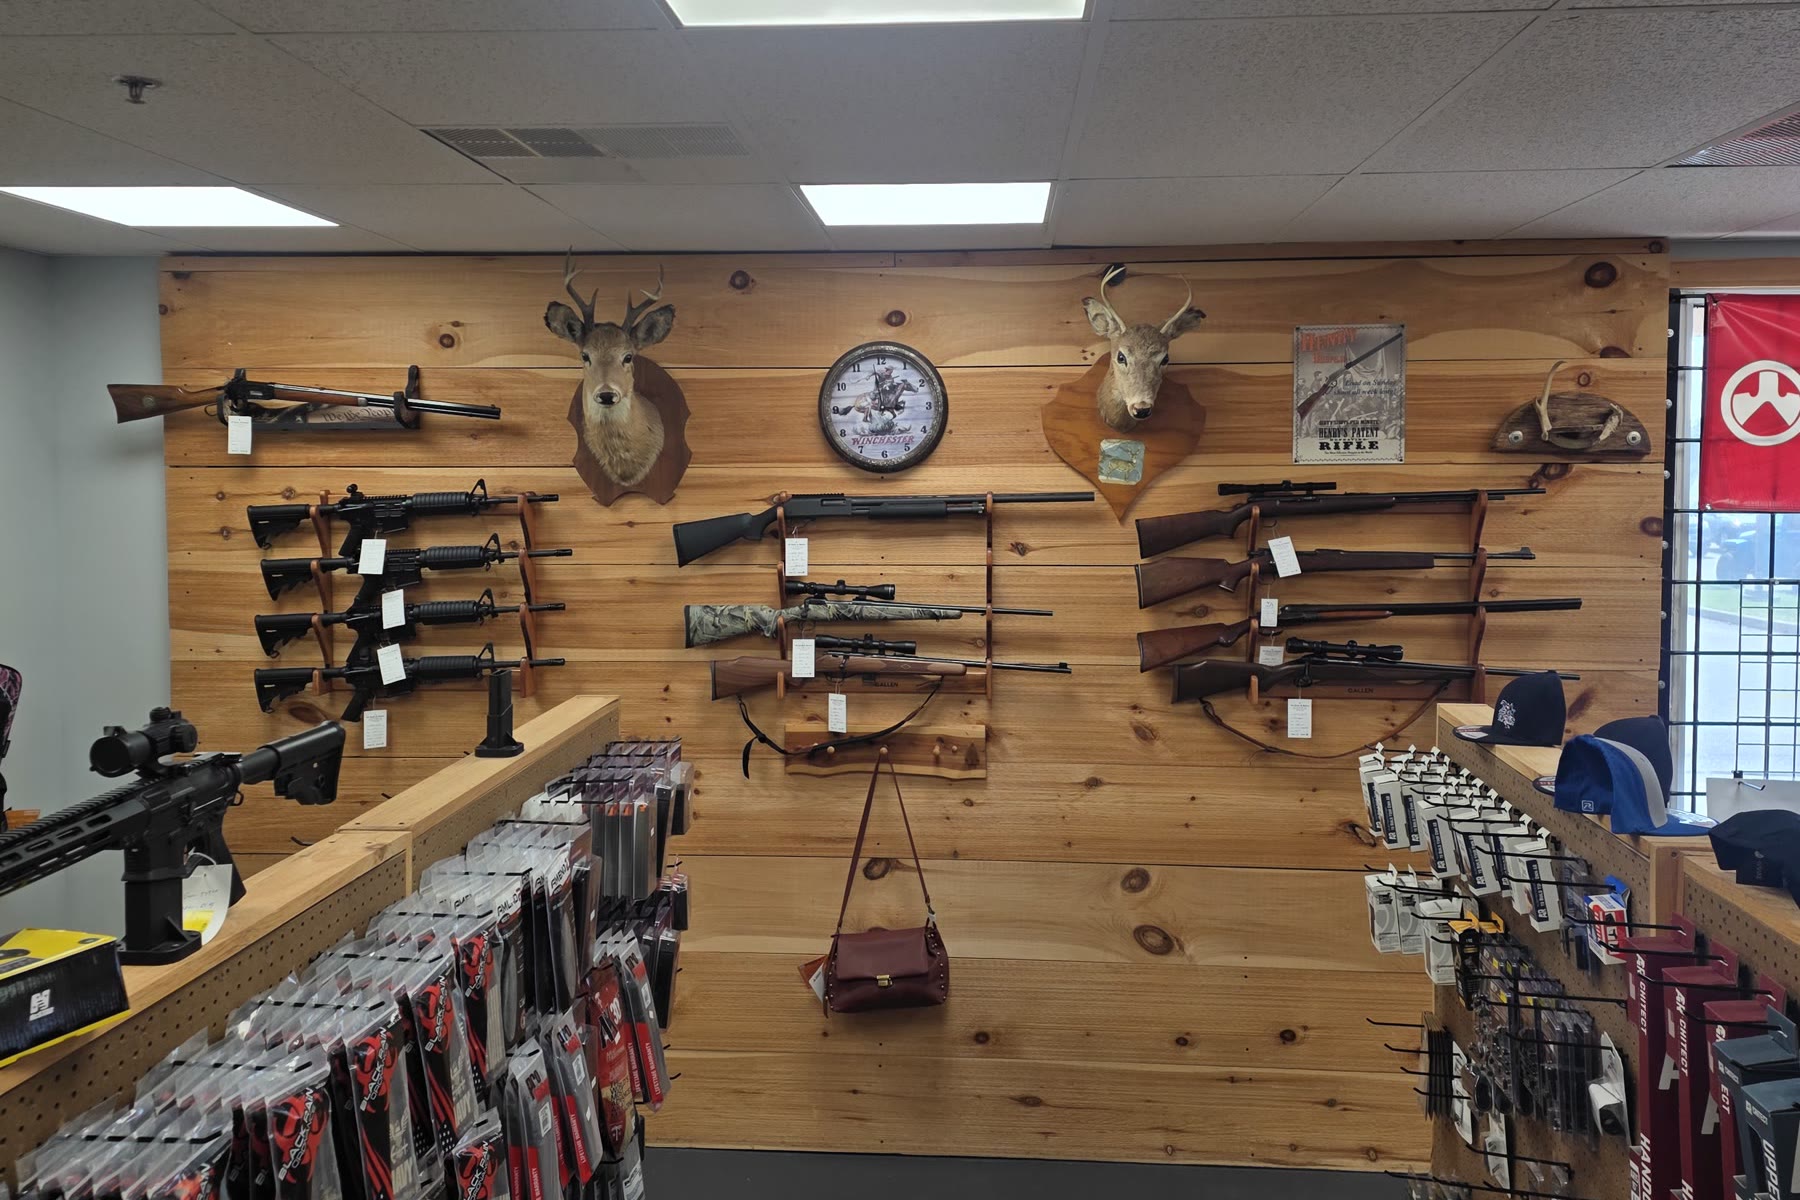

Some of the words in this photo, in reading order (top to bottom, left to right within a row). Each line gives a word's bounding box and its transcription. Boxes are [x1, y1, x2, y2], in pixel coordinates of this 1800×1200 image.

[877, 357, 887, 365] 12
[852, 364, 861, 373] 11
[837, 382, 847, 391] 10
[919, 379, 926, 387] 2
[832, 406, 840, 414] 9
[925, 402, 932, 410] 3
[360, 408, 394, 417] Peop
[840, 429, 846, 437] 8
[920, 426, 927, 434] 4
[1319, 427, 1347, 438] HENRY'S
[1352, 427, 1379, 438] PATENT
[851, 435, 915, 446] WINCHESTER
[858, 446, 864, 454] 7
[904, 443, 910, 452] 5
[1319, 441, 1379, 451] RIFLE
[881, 450, 888, 459] 6
[360, 1063, 383, 1111] BLACK
[278, 1125, 306, 1181] BLACK
[303, 1087, 314, 1126] RAIN
